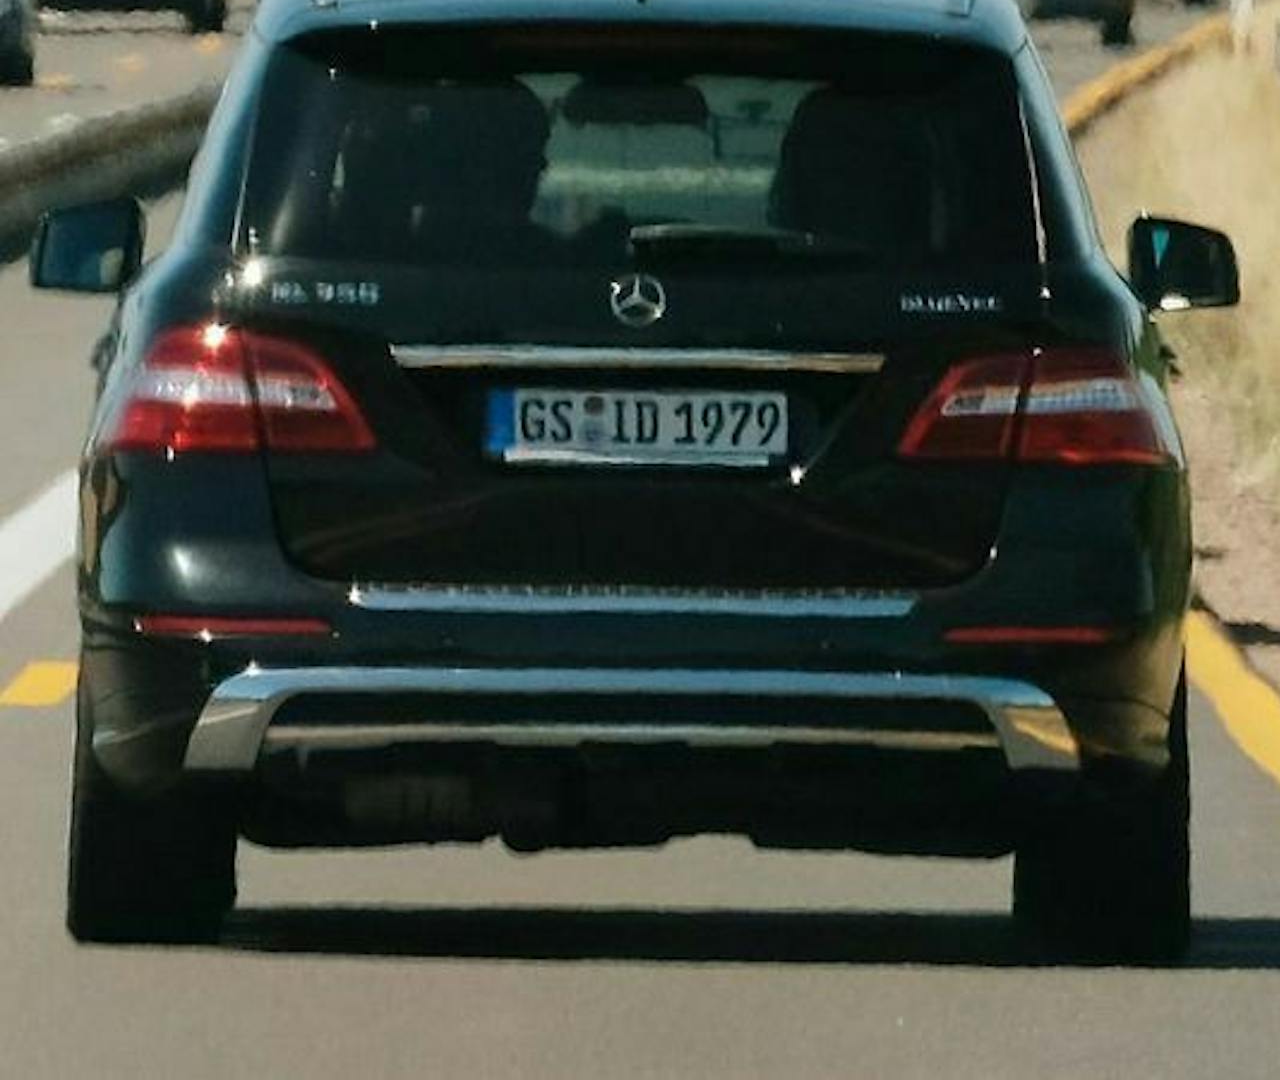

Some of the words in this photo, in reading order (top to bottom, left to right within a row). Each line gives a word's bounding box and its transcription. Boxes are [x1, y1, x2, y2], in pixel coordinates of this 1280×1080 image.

[520, 398, 573, 442] GS
[612, 399, 659, 444] ID
[674, 399, 780, 446] 1979
